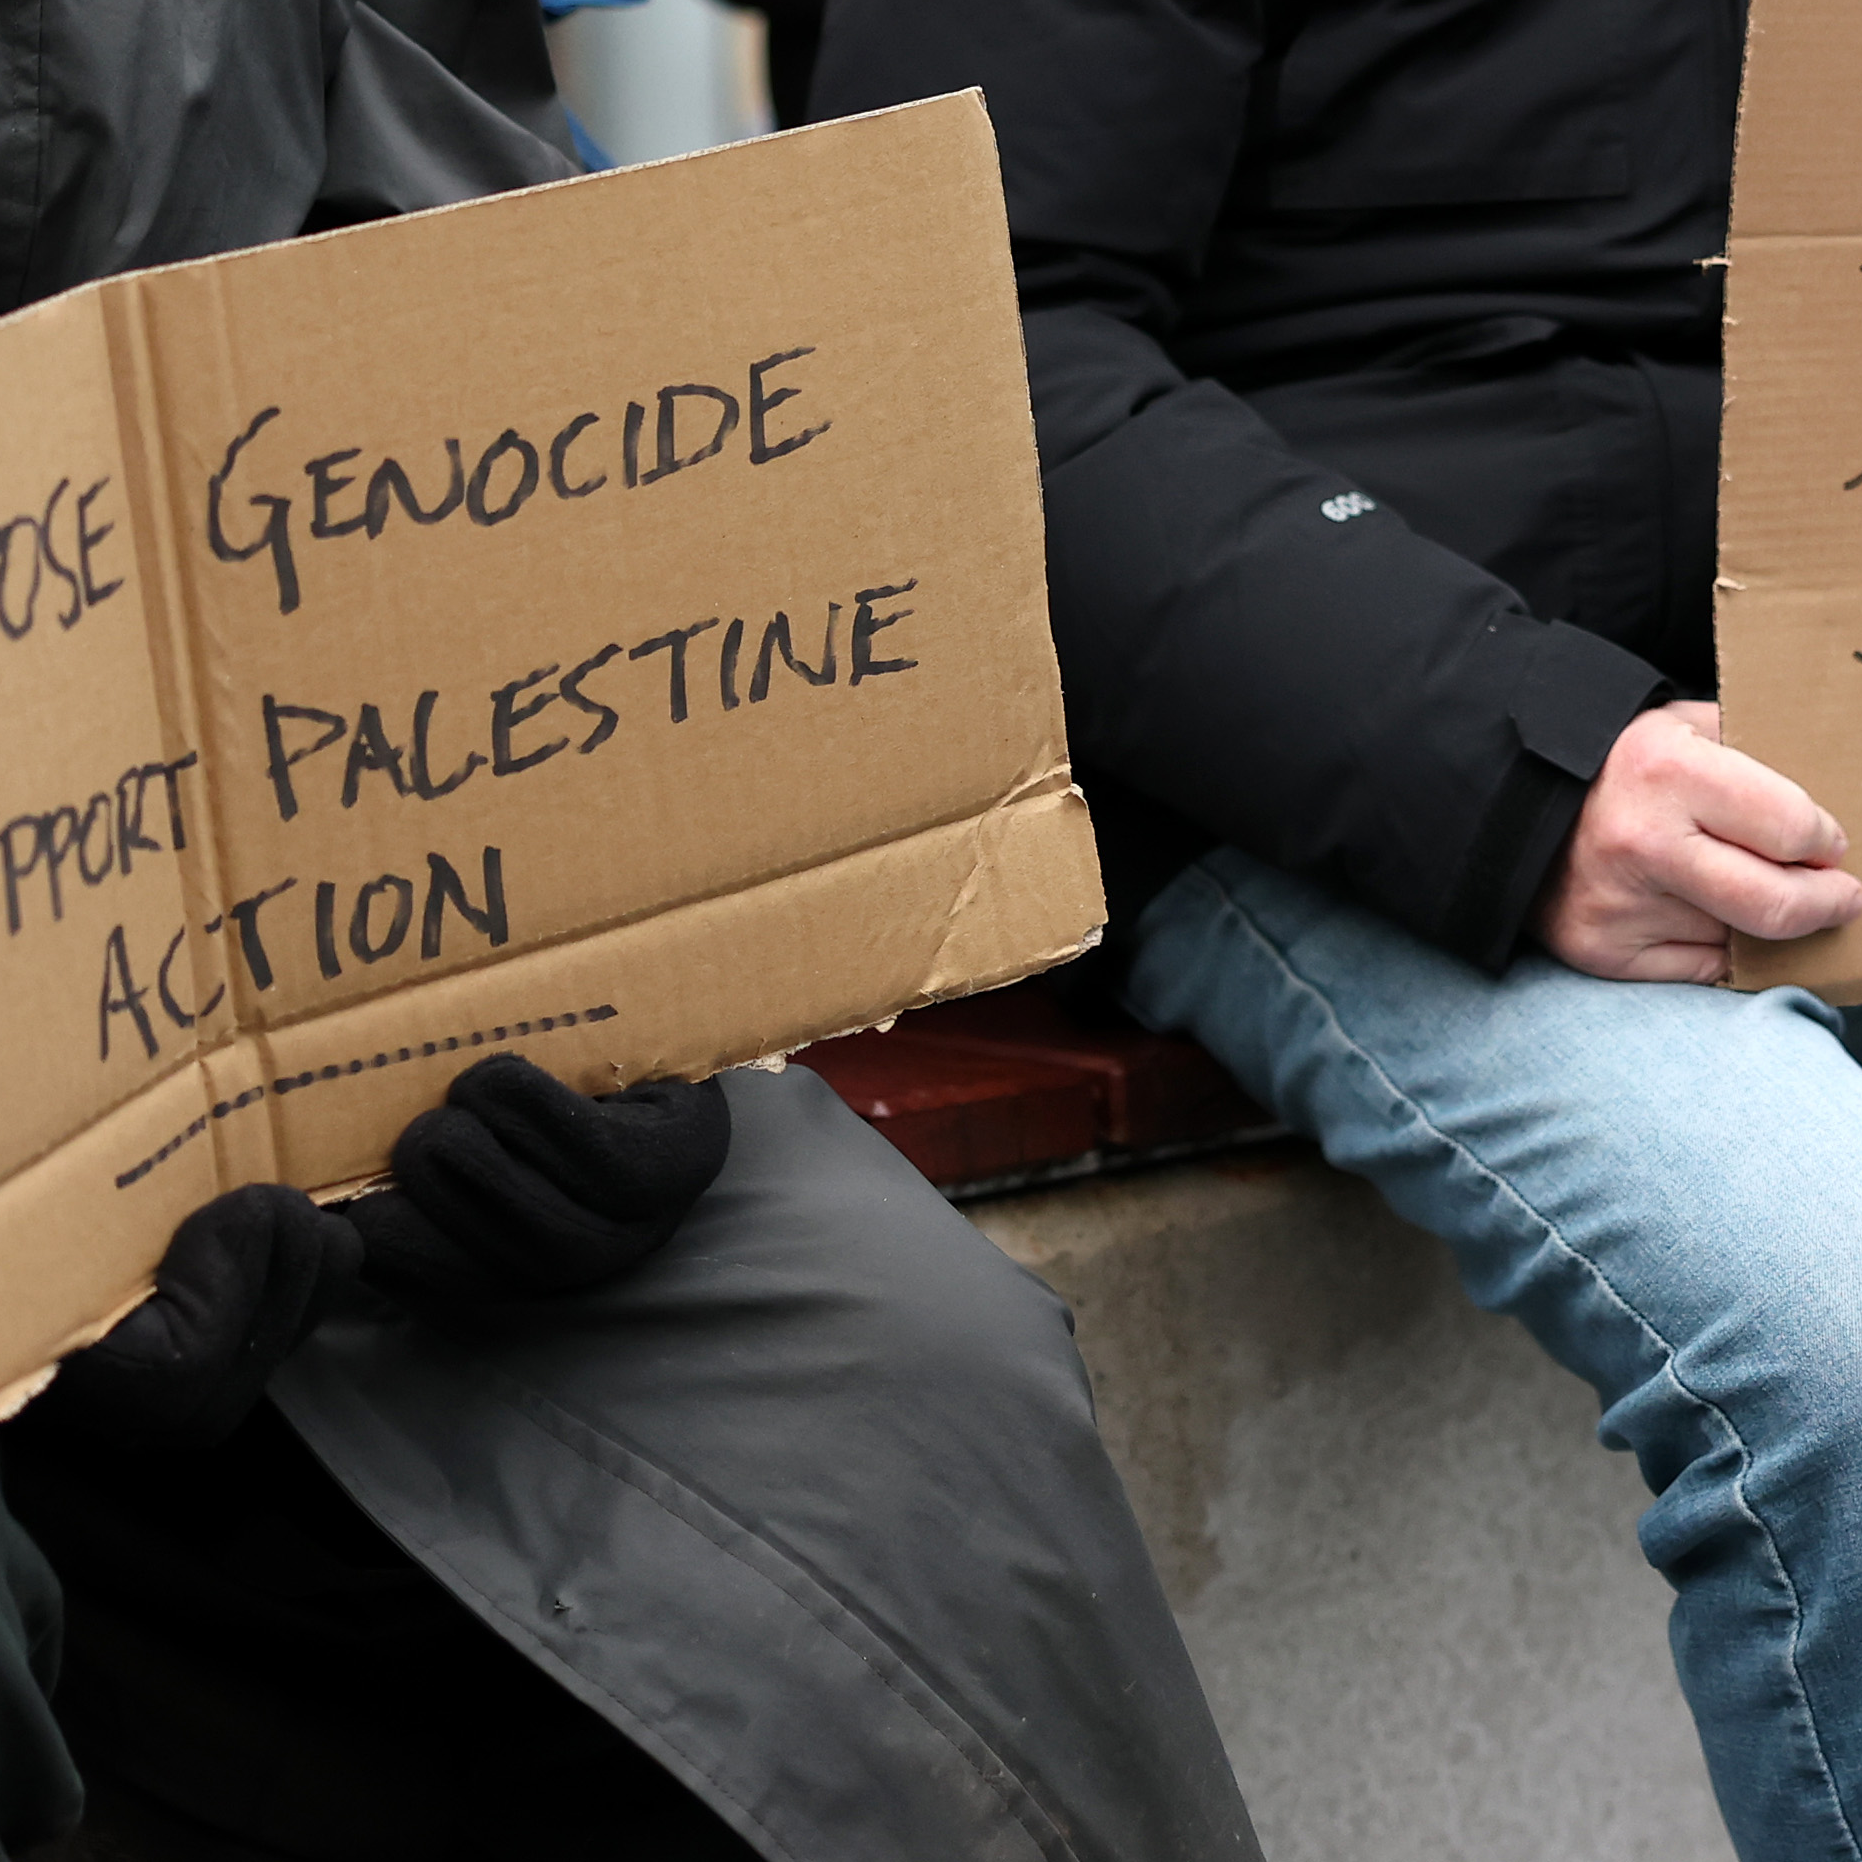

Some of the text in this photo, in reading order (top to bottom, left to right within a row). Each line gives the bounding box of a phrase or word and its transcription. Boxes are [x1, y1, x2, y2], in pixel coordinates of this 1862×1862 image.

[206, 346, 832, 615] GENOCIDE
[260, 578, 920, 823] PALESTINE
[98, 844, 511, 1063] ACTION
